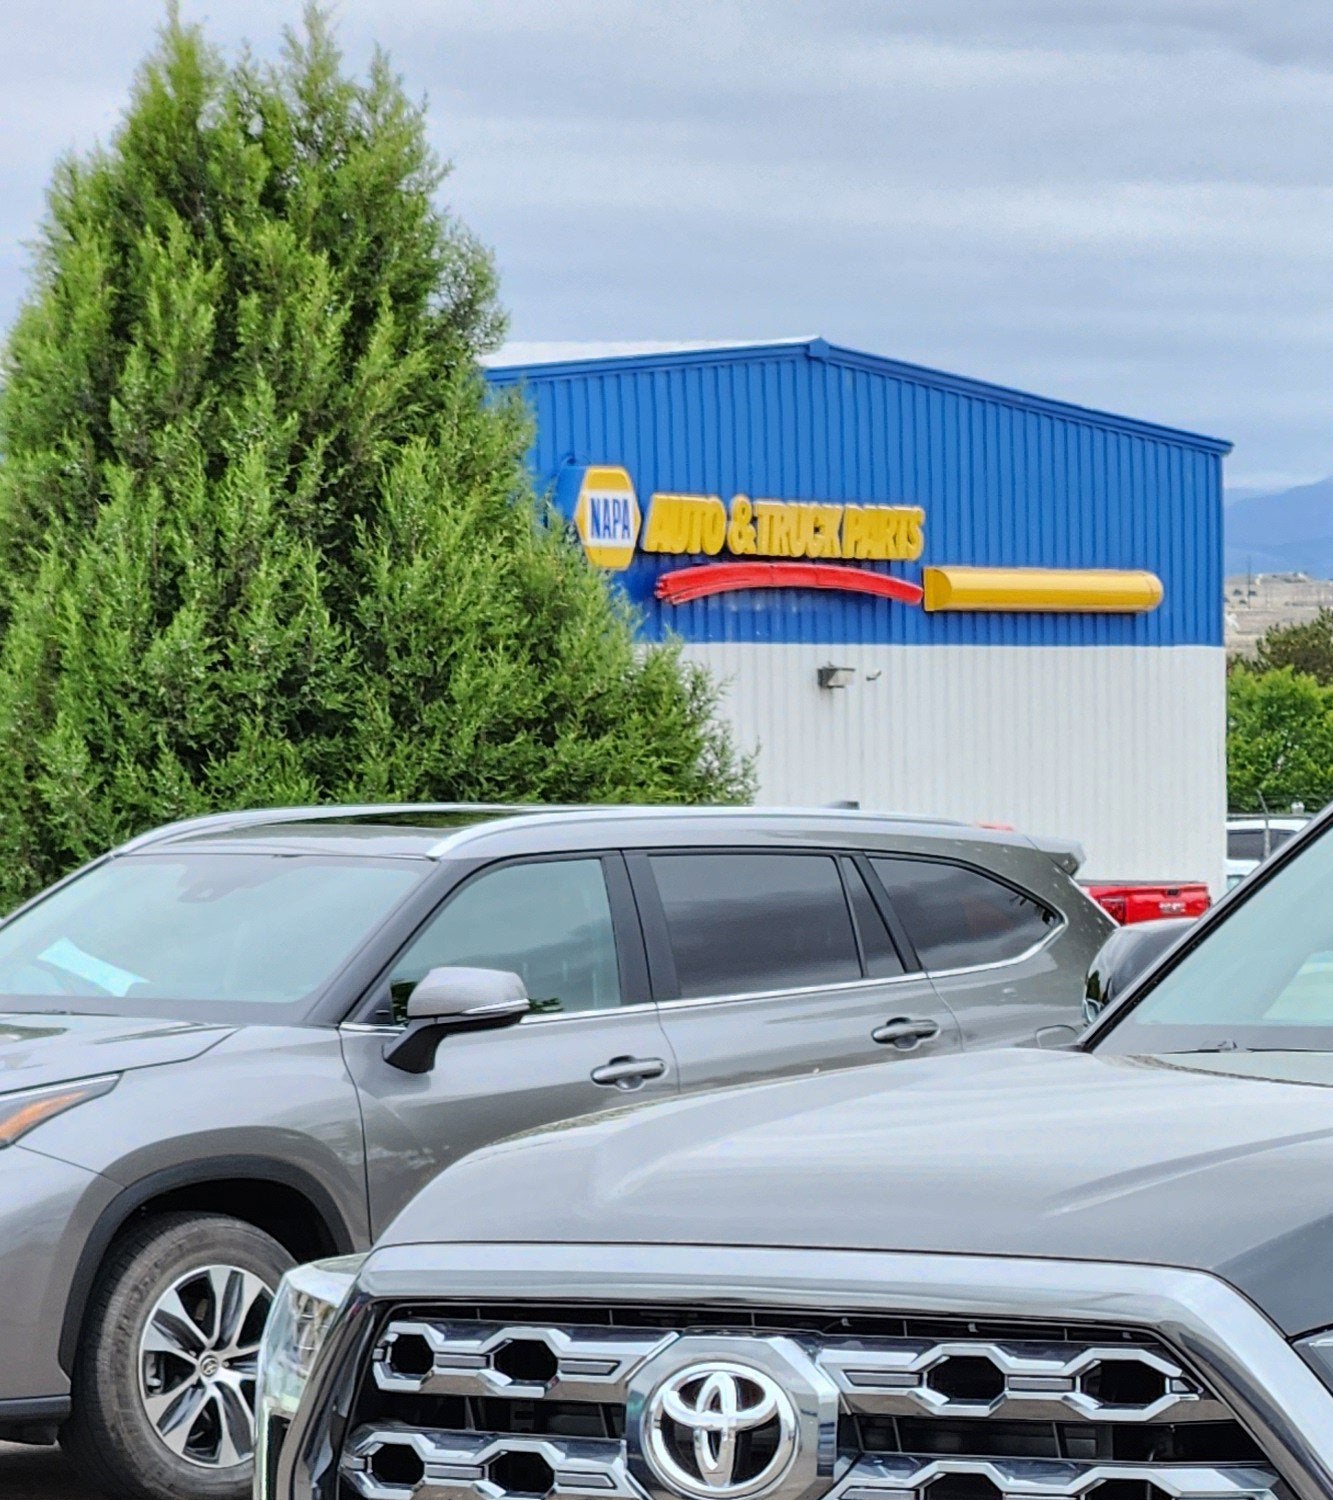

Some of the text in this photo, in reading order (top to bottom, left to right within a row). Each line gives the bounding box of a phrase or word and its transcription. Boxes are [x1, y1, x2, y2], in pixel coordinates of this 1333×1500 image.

[590, 498, 631, 539] NAPA
[643, 494, 925, 561] AUTO & TRUCK PARTS
